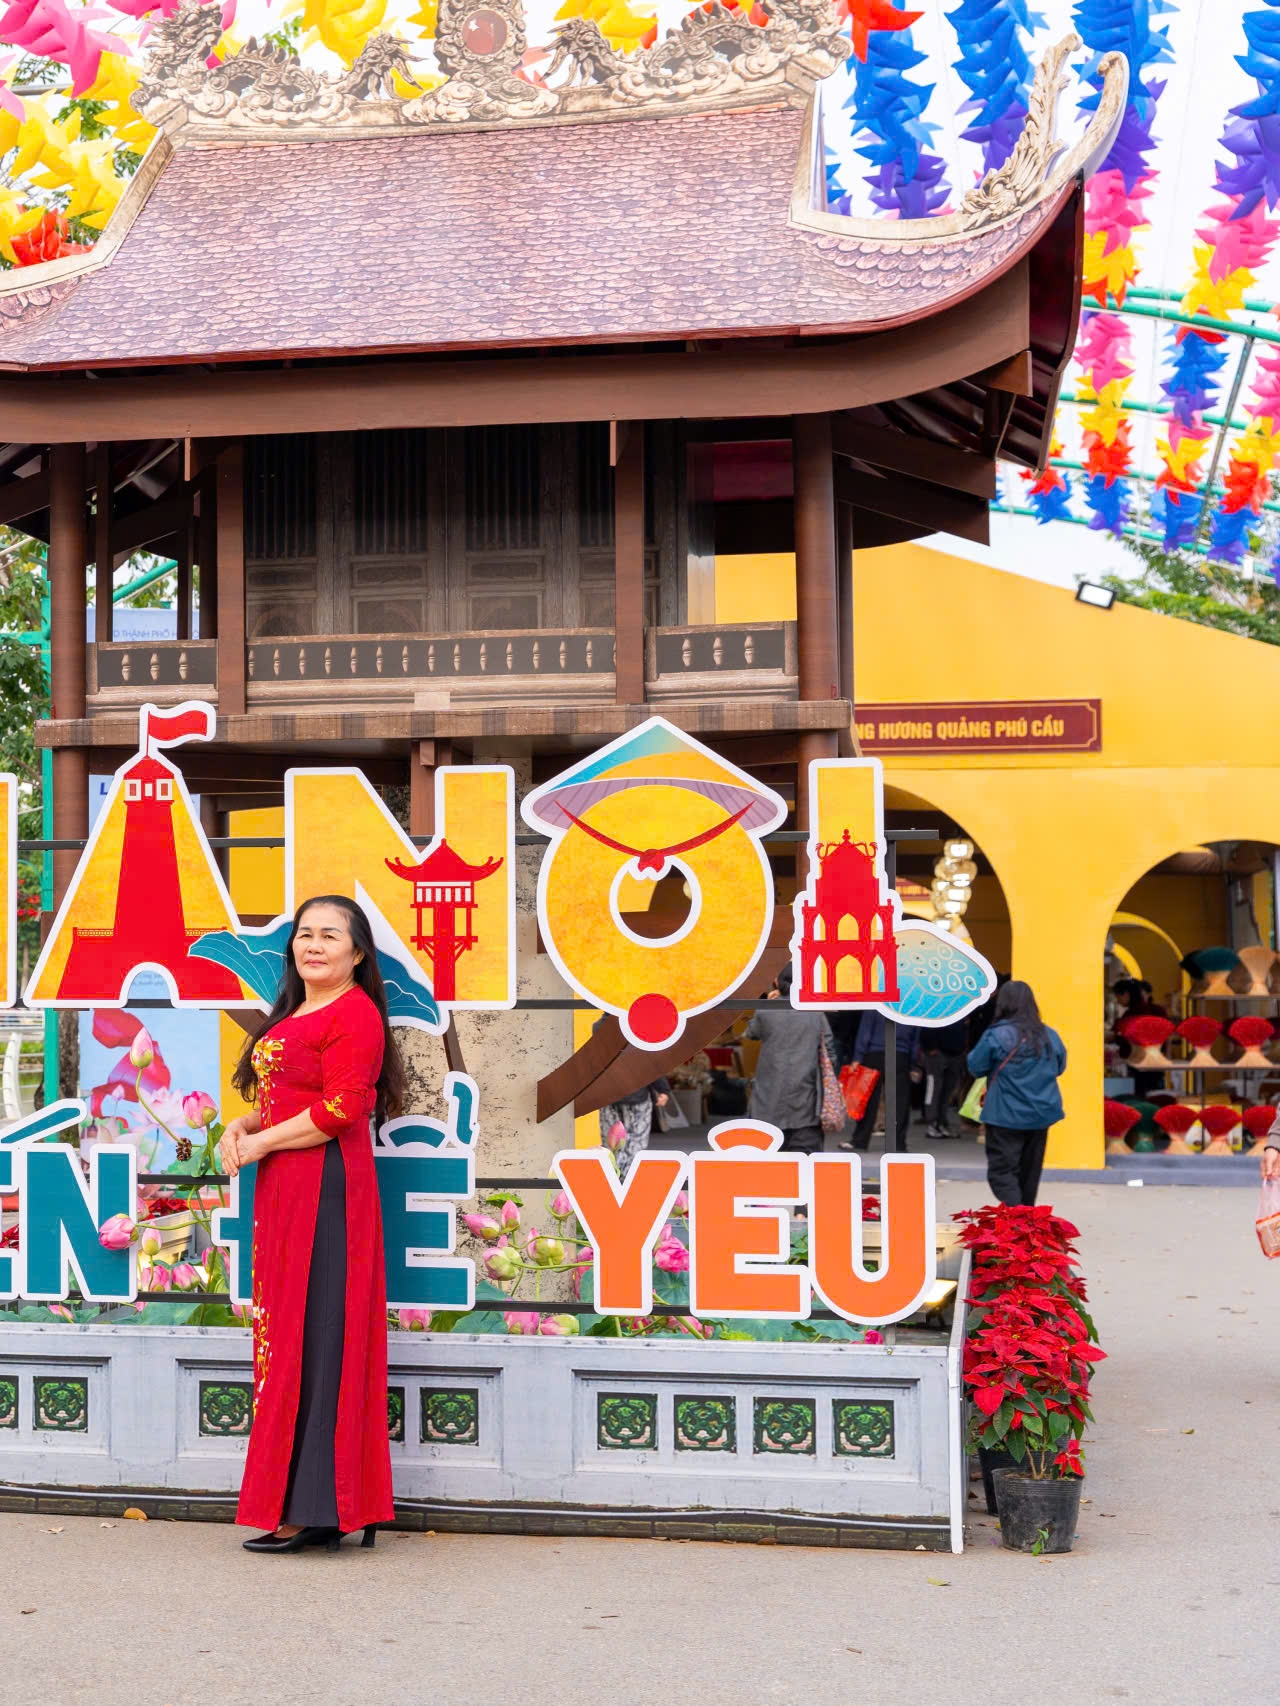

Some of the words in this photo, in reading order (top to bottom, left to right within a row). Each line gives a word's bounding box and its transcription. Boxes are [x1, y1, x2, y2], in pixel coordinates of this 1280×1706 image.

[878, 720, 933, 740] HƯƠNG
[936, 716, 991, 741] QUẢNG
[211, 1072, 478, 1310] Ể
[553, 1119, 936, 1324] YÊU
